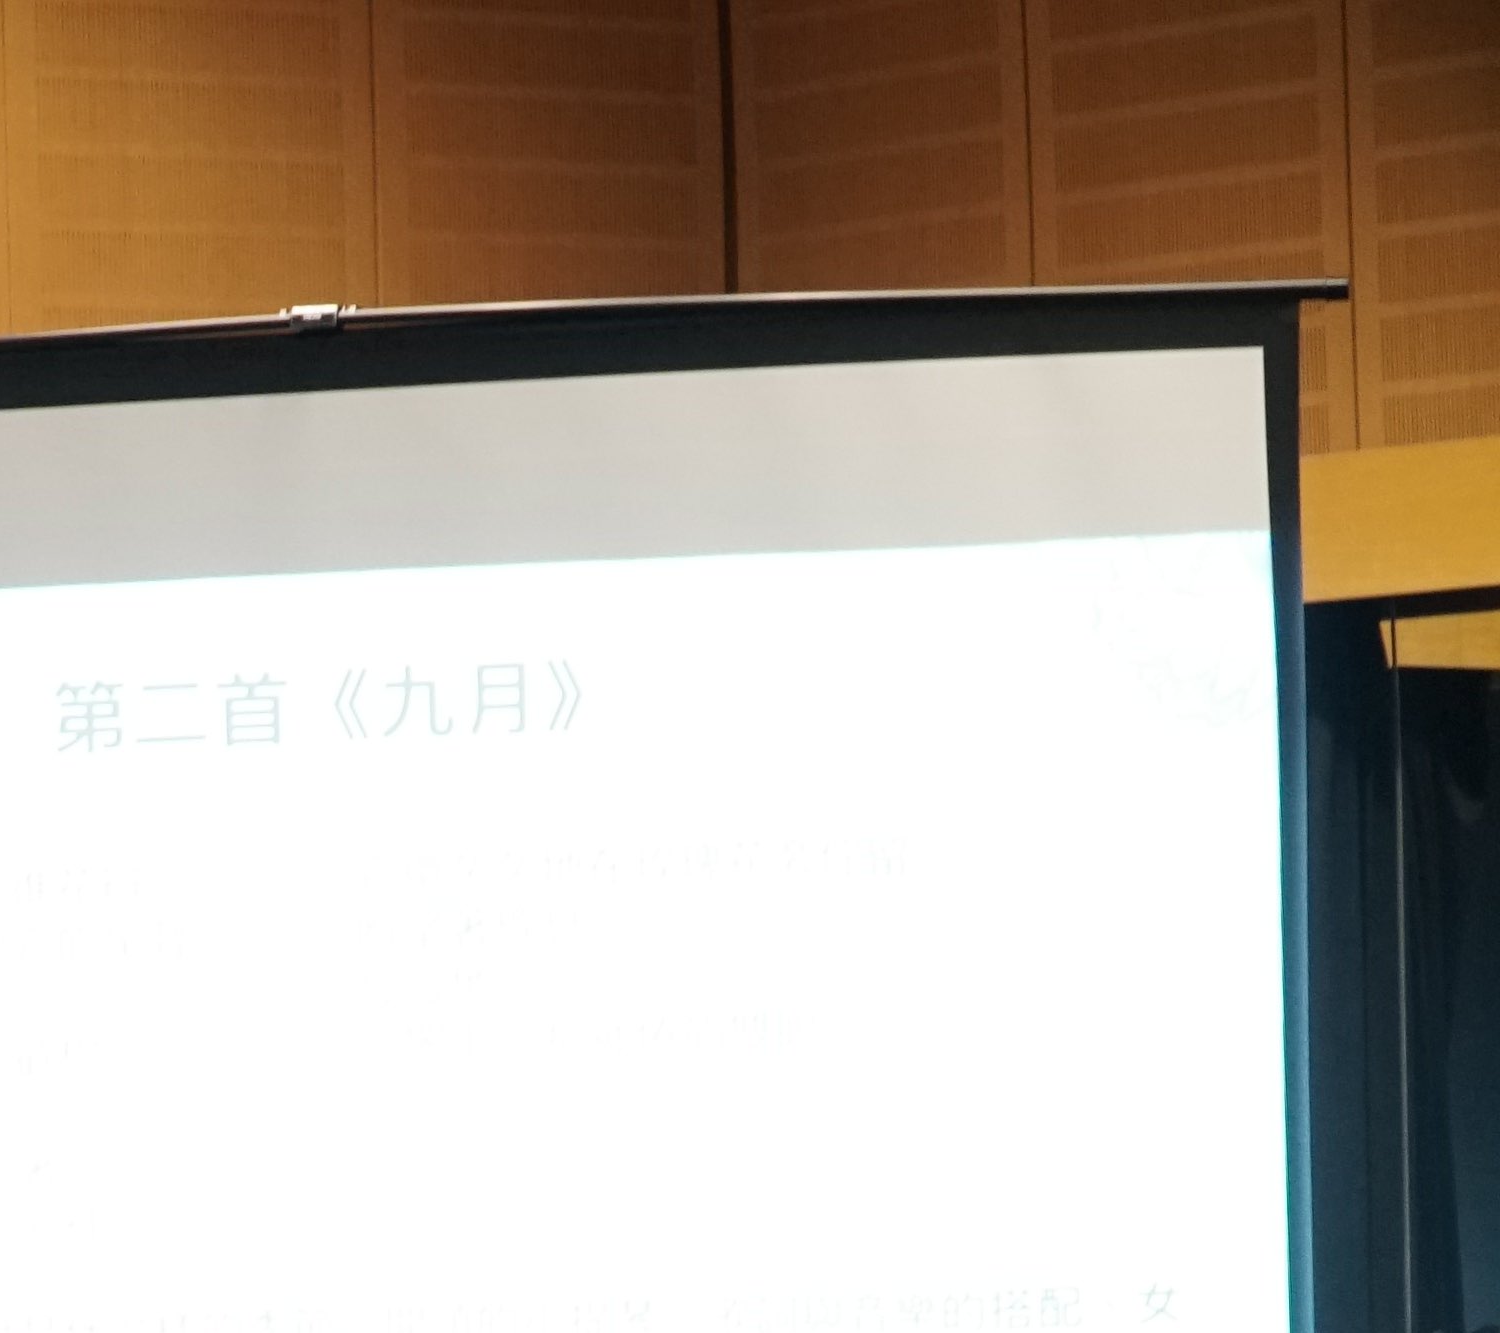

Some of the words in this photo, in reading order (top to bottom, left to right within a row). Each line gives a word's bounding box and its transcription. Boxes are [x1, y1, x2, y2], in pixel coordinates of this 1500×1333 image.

[54, 659, 582, 753] 第二首《九月》
